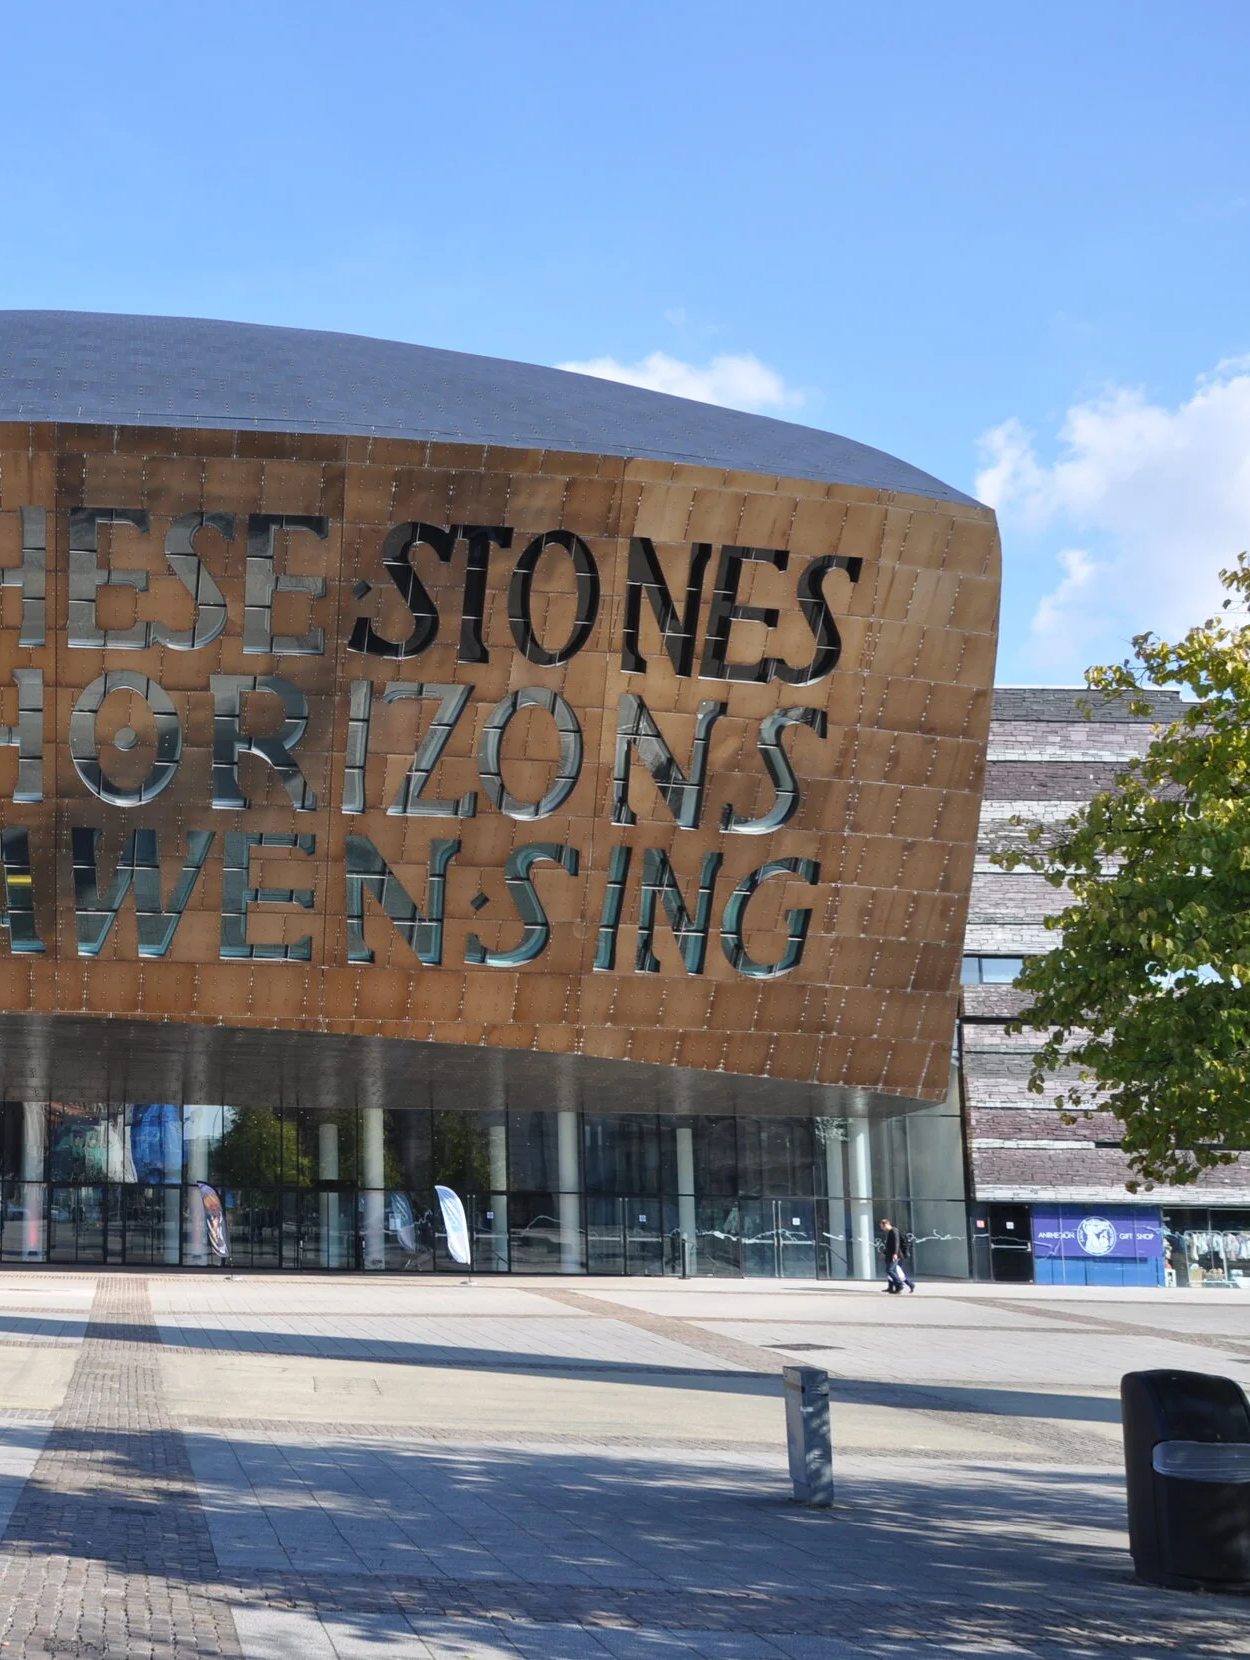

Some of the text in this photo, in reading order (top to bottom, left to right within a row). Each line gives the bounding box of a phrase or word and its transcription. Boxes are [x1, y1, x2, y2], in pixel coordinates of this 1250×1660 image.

[347, 521, 862, 686] STONES
[463, 842, 821, 978] SING
[1136, 1232, 1155, 1240] SHOP
